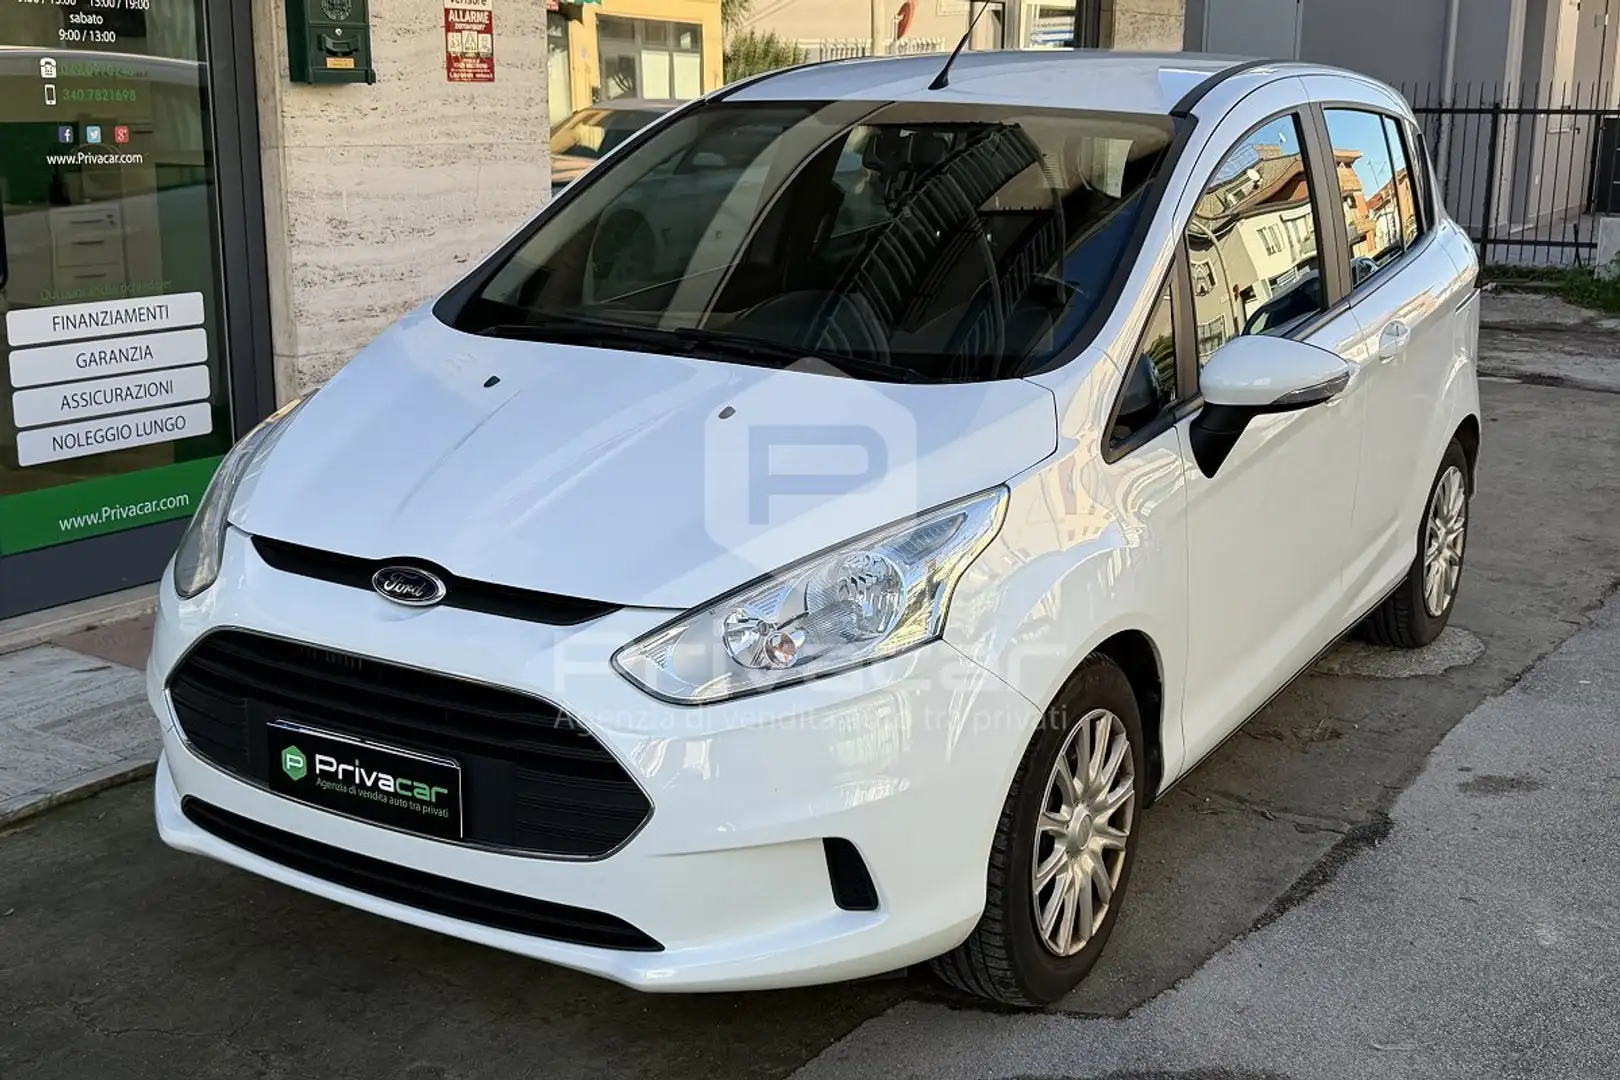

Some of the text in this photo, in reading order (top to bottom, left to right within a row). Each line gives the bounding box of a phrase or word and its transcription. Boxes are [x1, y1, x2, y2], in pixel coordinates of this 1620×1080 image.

[69, 11, 104, 25] sabato
[448, 10, 490, 23] ALLARME
[58, 29, 80, 41] 9:00
[90, 30, 116, 42] 13:00
[46, 152, 143, 165] www.Privacar.com
[52, 304, 169, 331] FINANZIAMENTI
[76, 345, 154, 368] GARANZIA
[61, 380, 173, 411] ASSICURAZIONI
[52, 415, 186, 451] NOLEGGIO LUNGO
[59, 493, 189, 532] www.Privacar.com
[384, 572, 428, 597] Ford
[315, 754, 448, 803] Privacar
[316, 777, 449, 818] Agenzia di vendita auto tra privati
